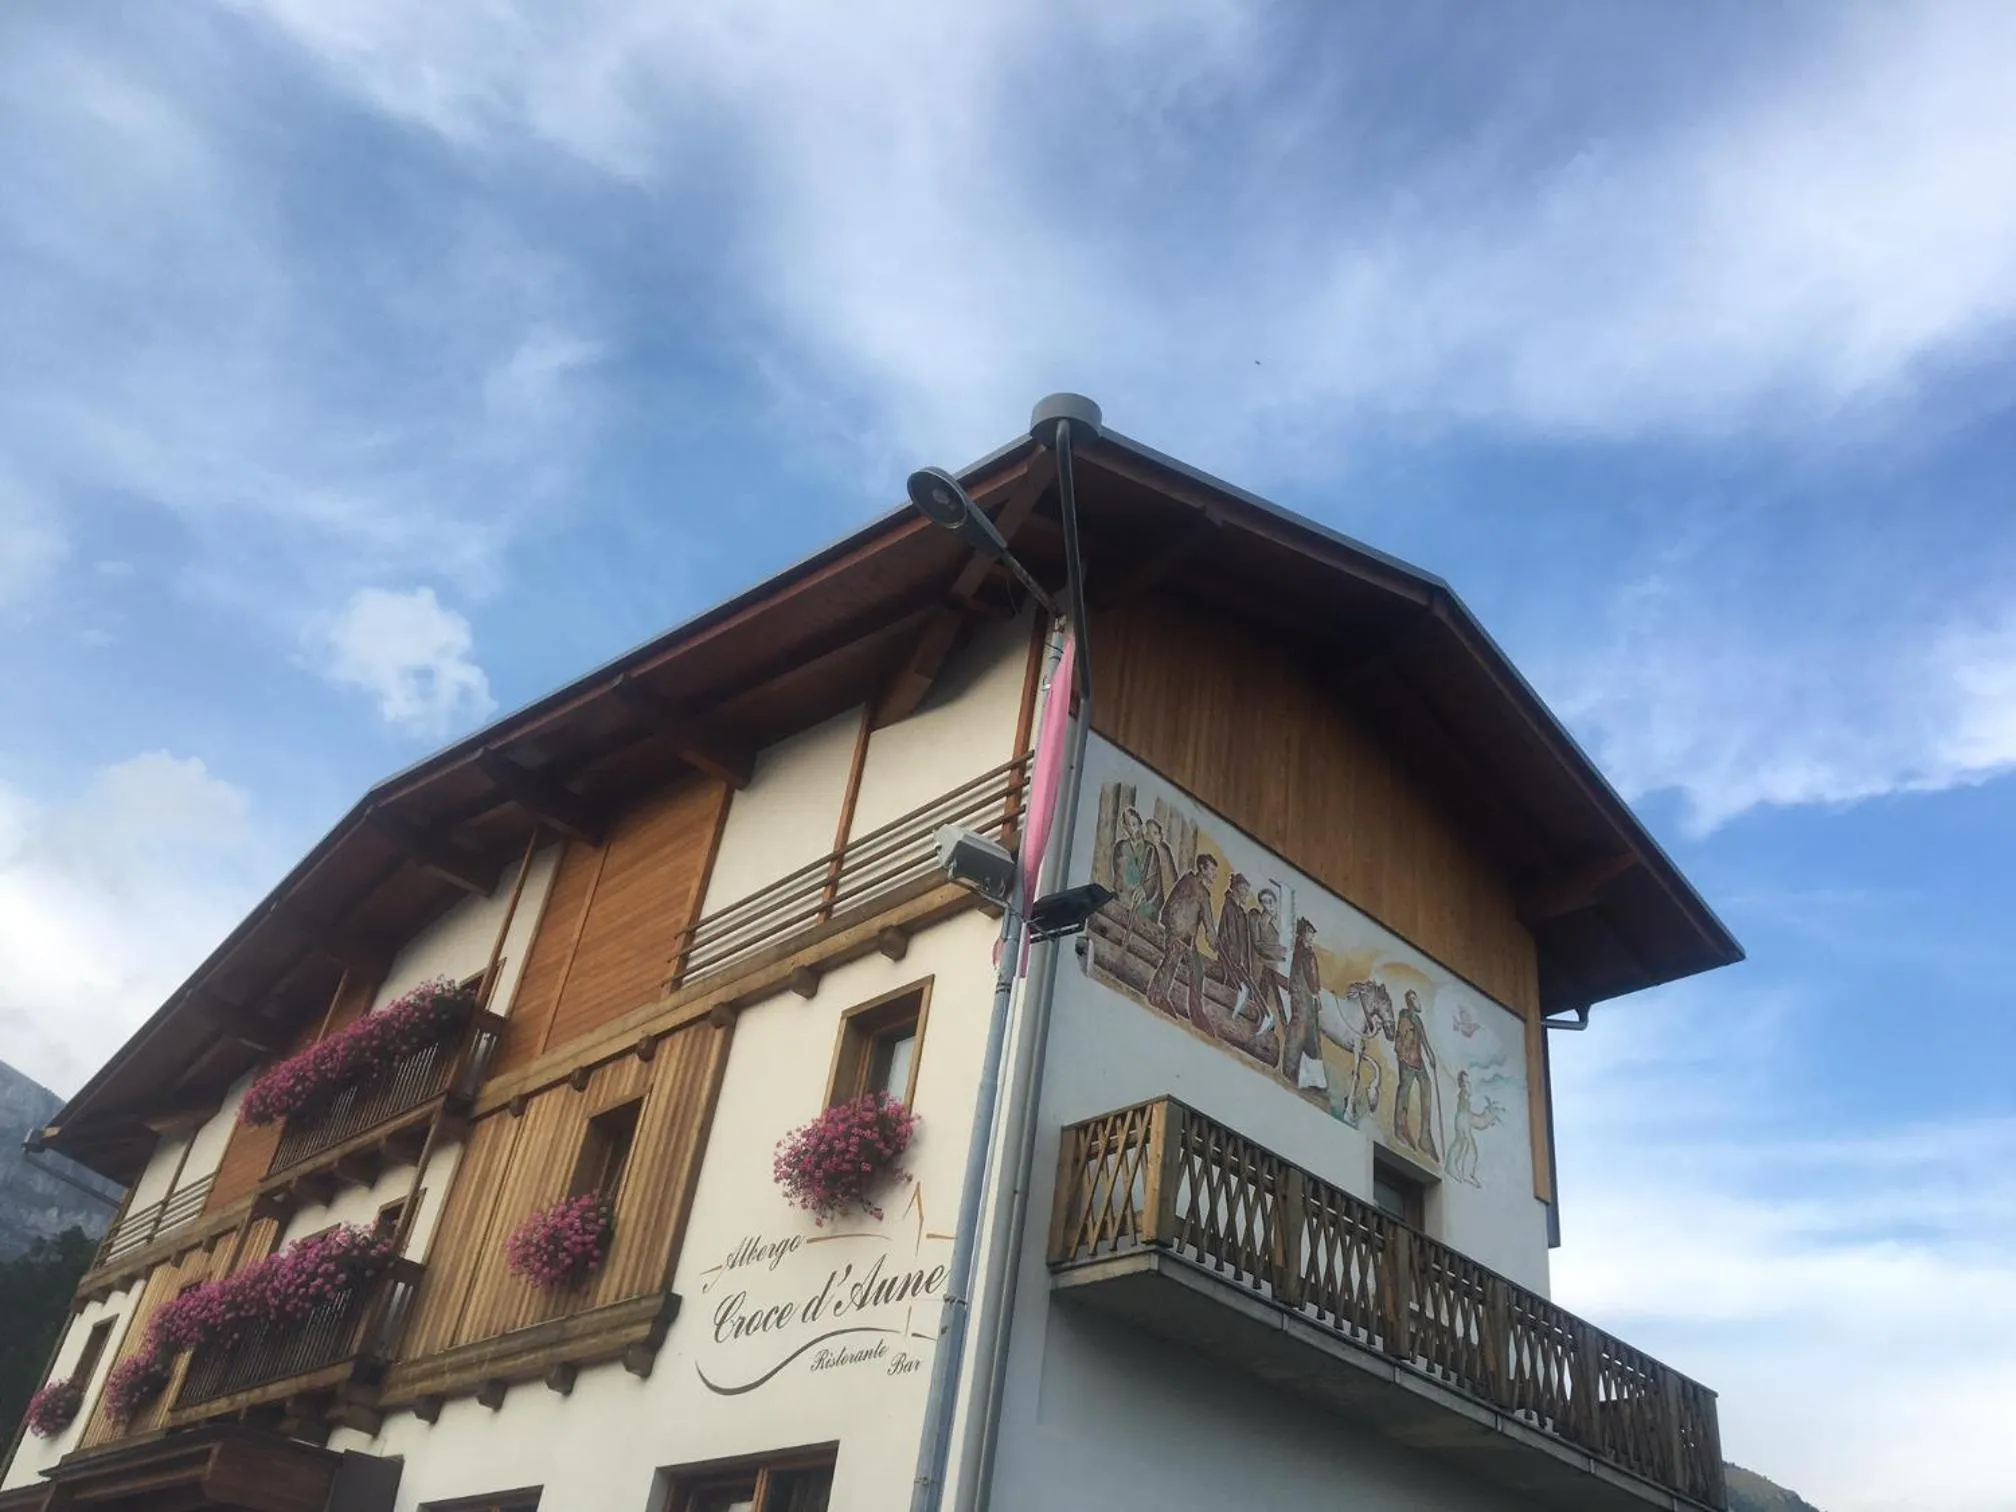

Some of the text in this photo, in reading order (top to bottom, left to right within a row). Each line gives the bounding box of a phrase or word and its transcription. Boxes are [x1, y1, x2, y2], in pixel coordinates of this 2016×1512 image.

[714, 1253, 951, 1343] Croce d'Aune
[810, 1338, 922, 1375] Ristorante Bar
